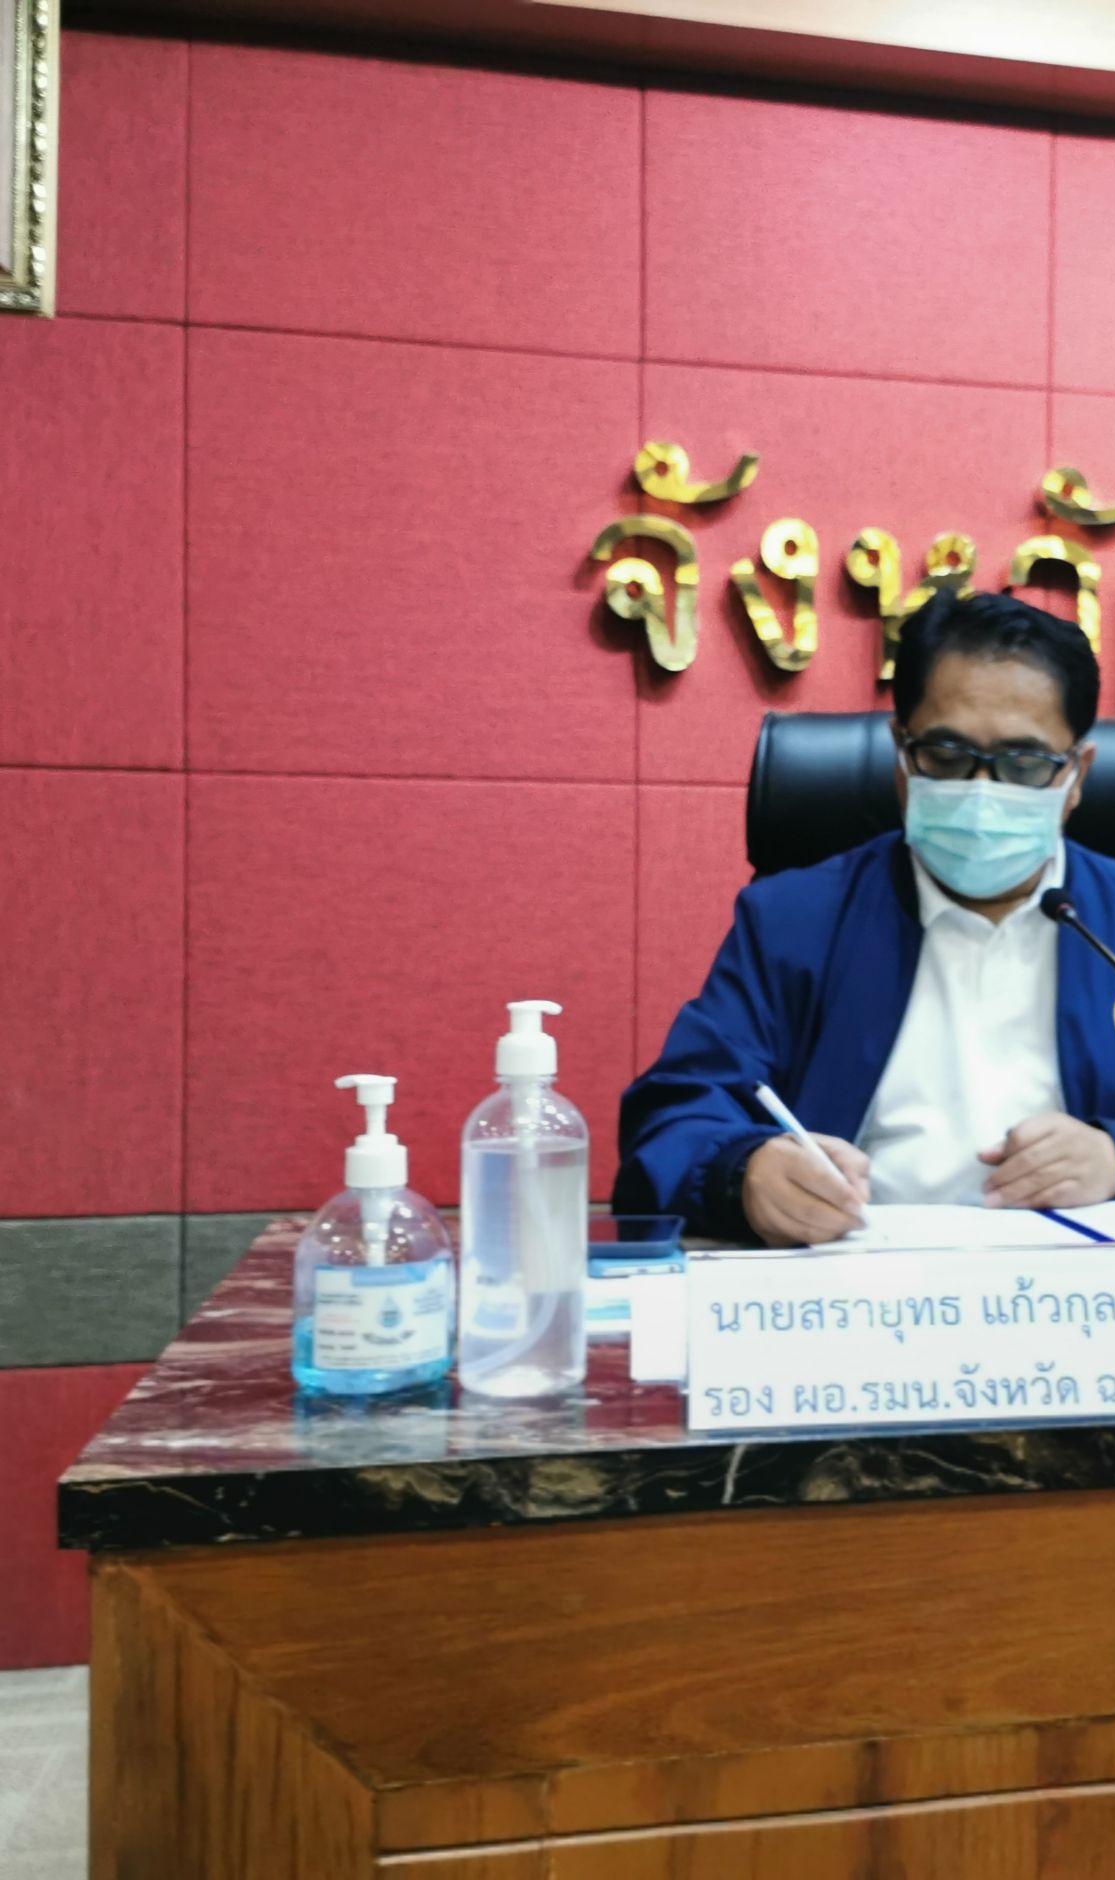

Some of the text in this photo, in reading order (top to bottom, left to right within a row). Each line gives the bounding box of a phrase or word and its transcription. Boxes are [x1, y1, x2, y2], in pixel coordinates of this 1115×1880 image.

[710, 1295, 961, 1344] นายสรายุทธ
[703, 1385, 774, 1417] รอง
[794, 1361, 1080, 1414] ผอ.รมน.จังหวัด
